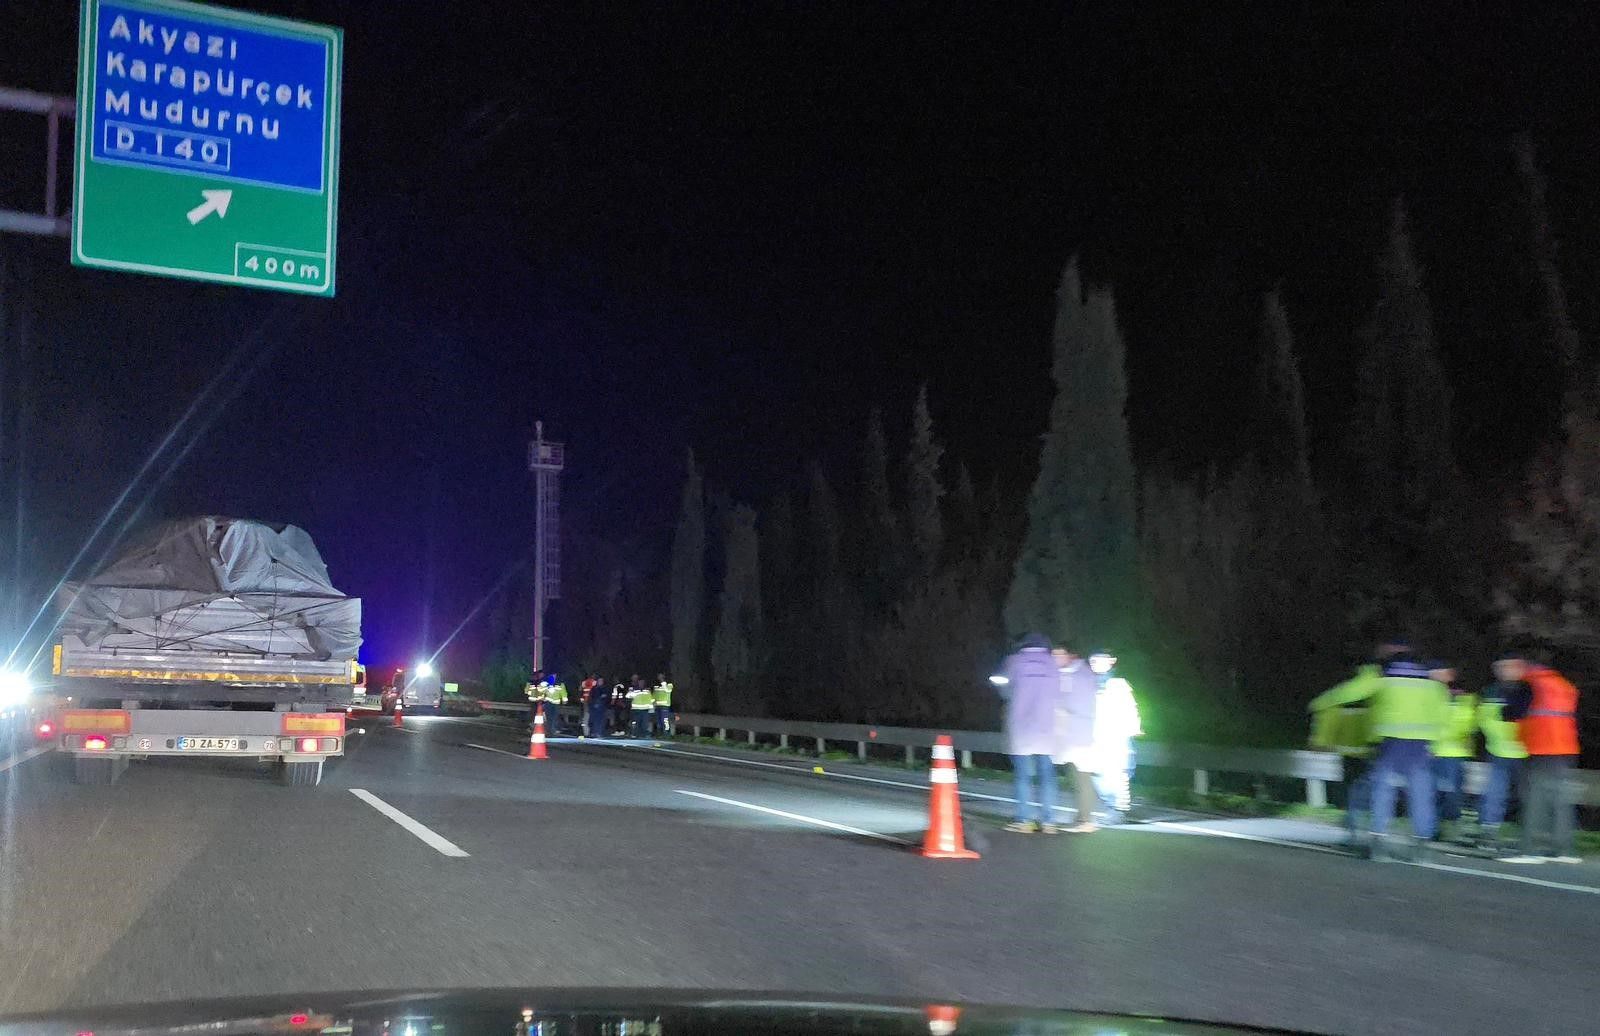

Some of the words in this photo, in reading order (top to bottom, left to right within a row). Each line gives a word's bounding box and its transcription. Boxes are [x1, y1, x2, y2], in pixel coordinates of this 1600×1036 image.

[109, 15, 237, 60] Akyazı
[105, 88, 280, 140] Mudurnu
[116, 127, 219, 163] D.140
